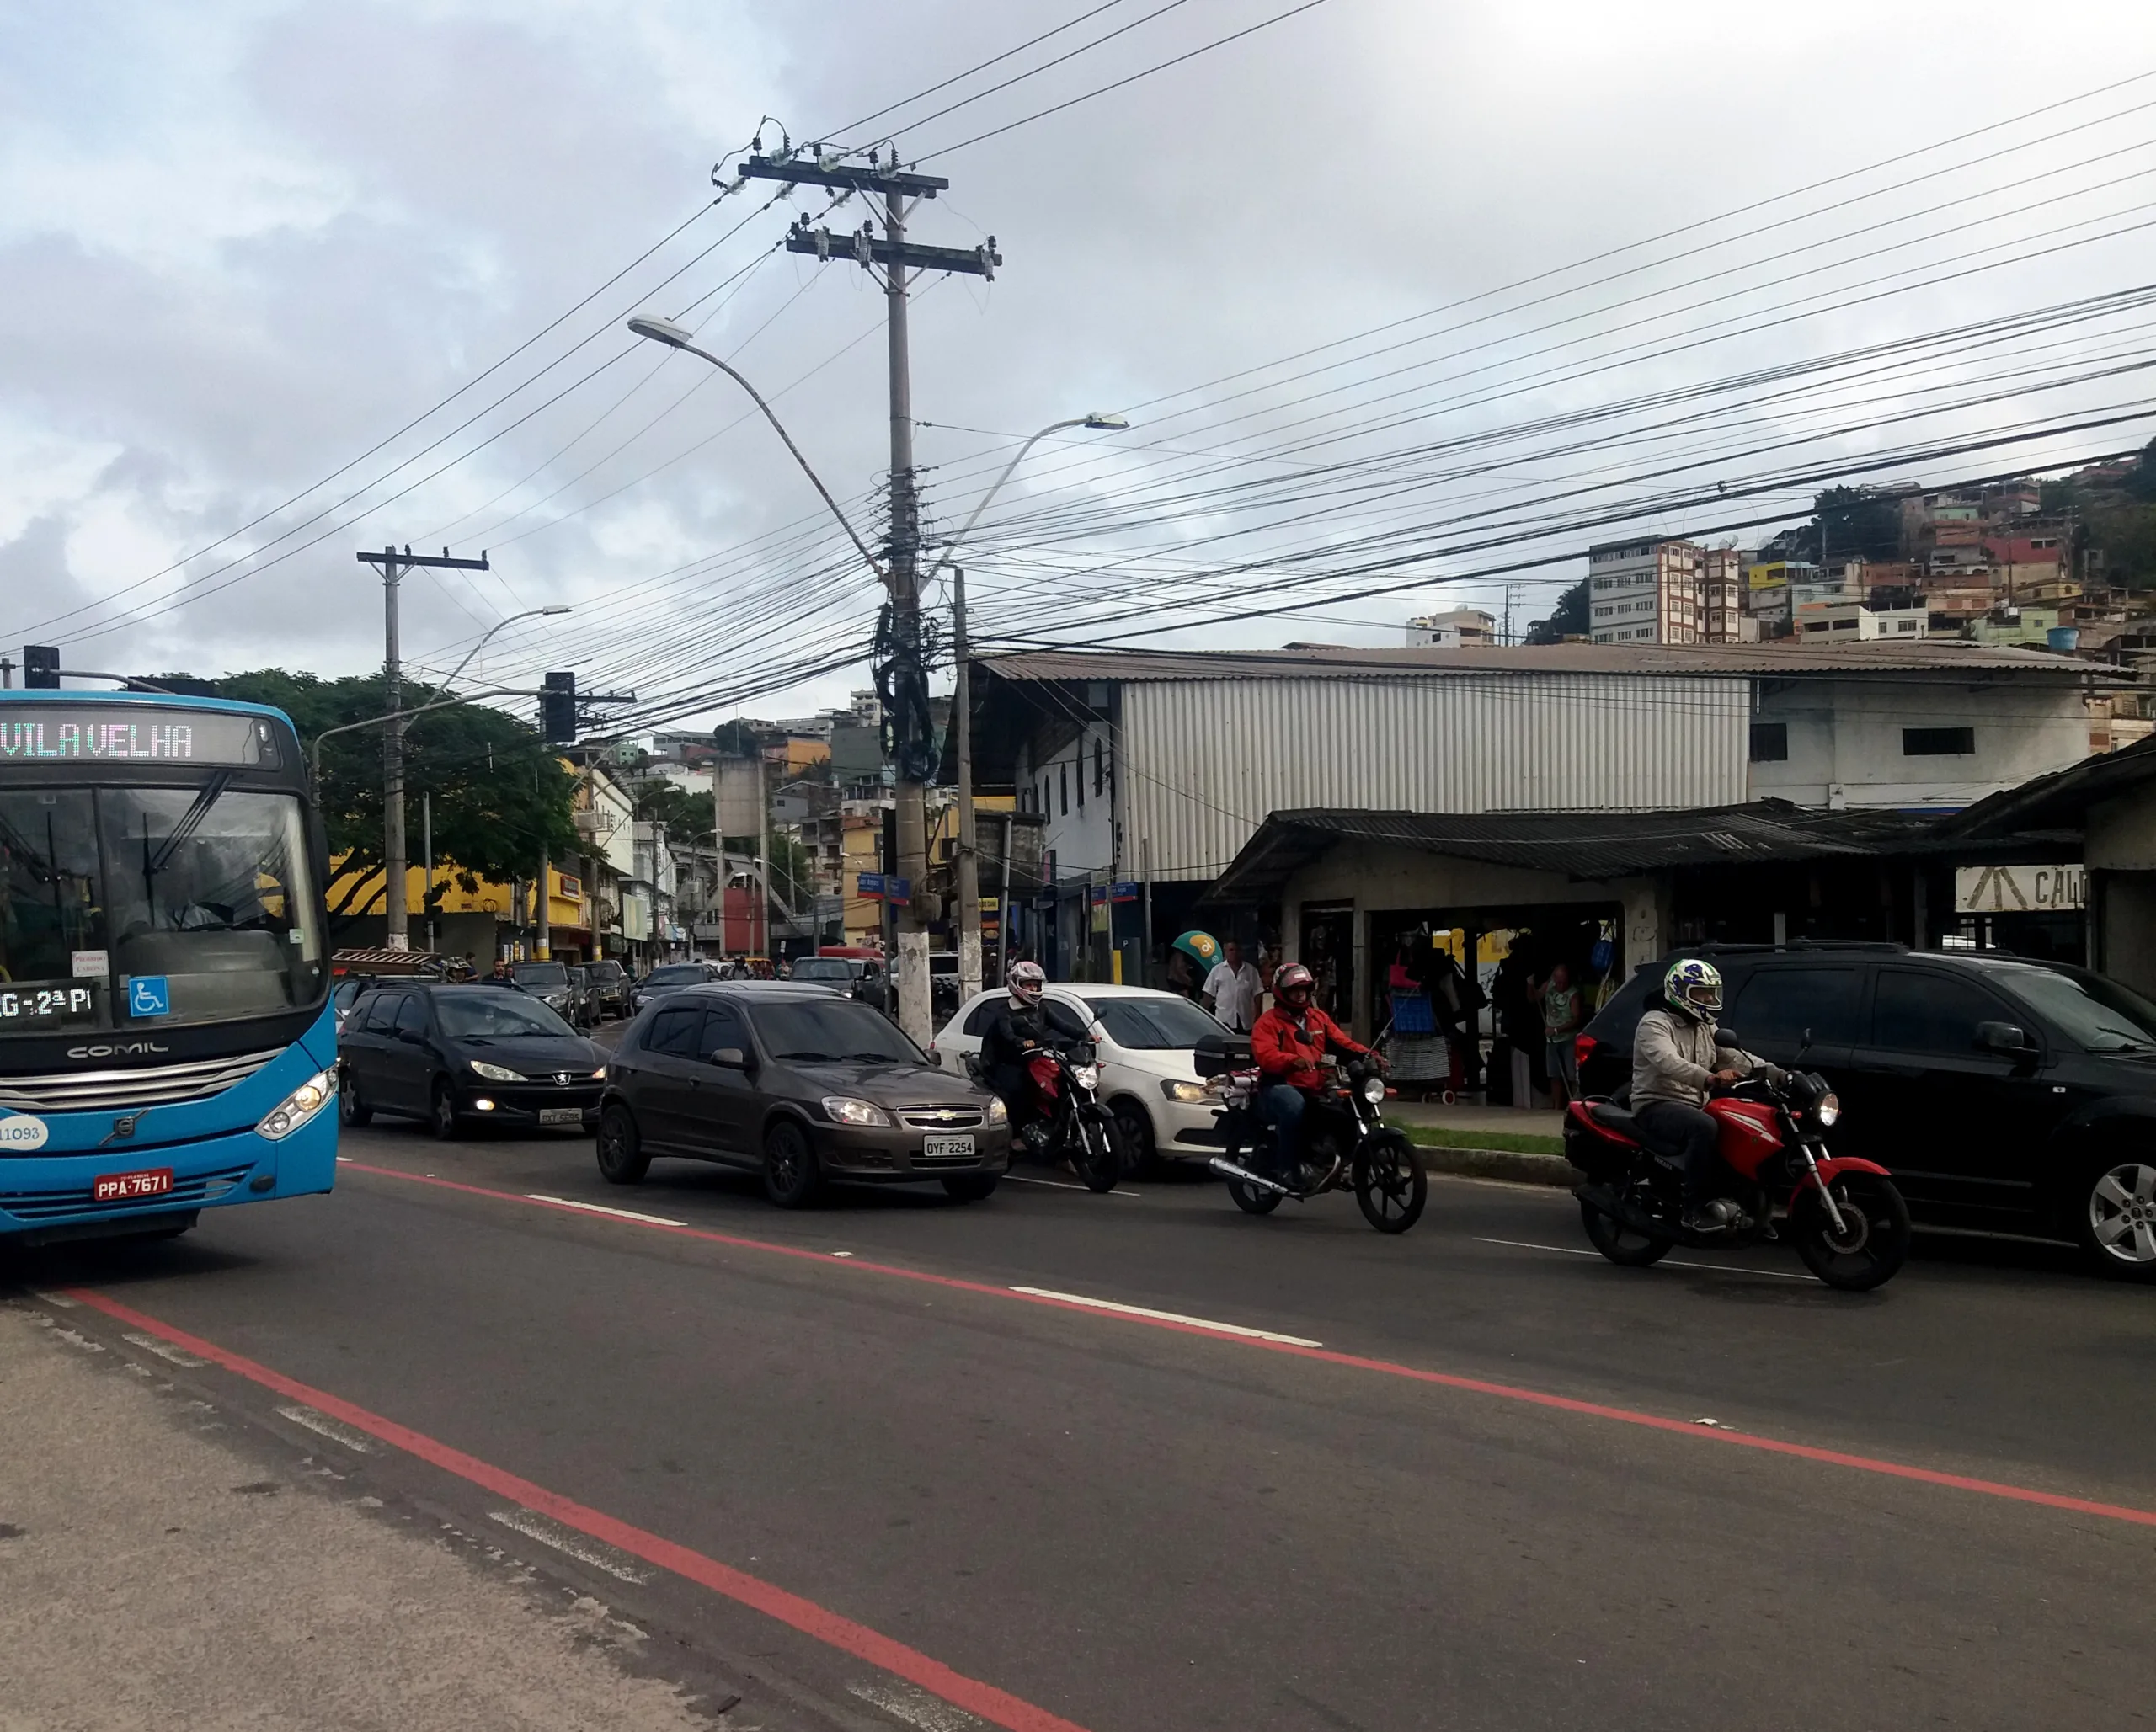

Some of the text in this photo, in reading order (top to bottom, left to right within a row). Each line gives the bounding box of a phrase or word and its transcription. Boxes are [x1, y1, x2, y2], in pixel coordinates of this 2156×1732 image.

[0, 722, 191, 757] VILA VELHA
[1201, 940, 1211, 952] oi
[67, 1042, 170, 1059] COMIL
